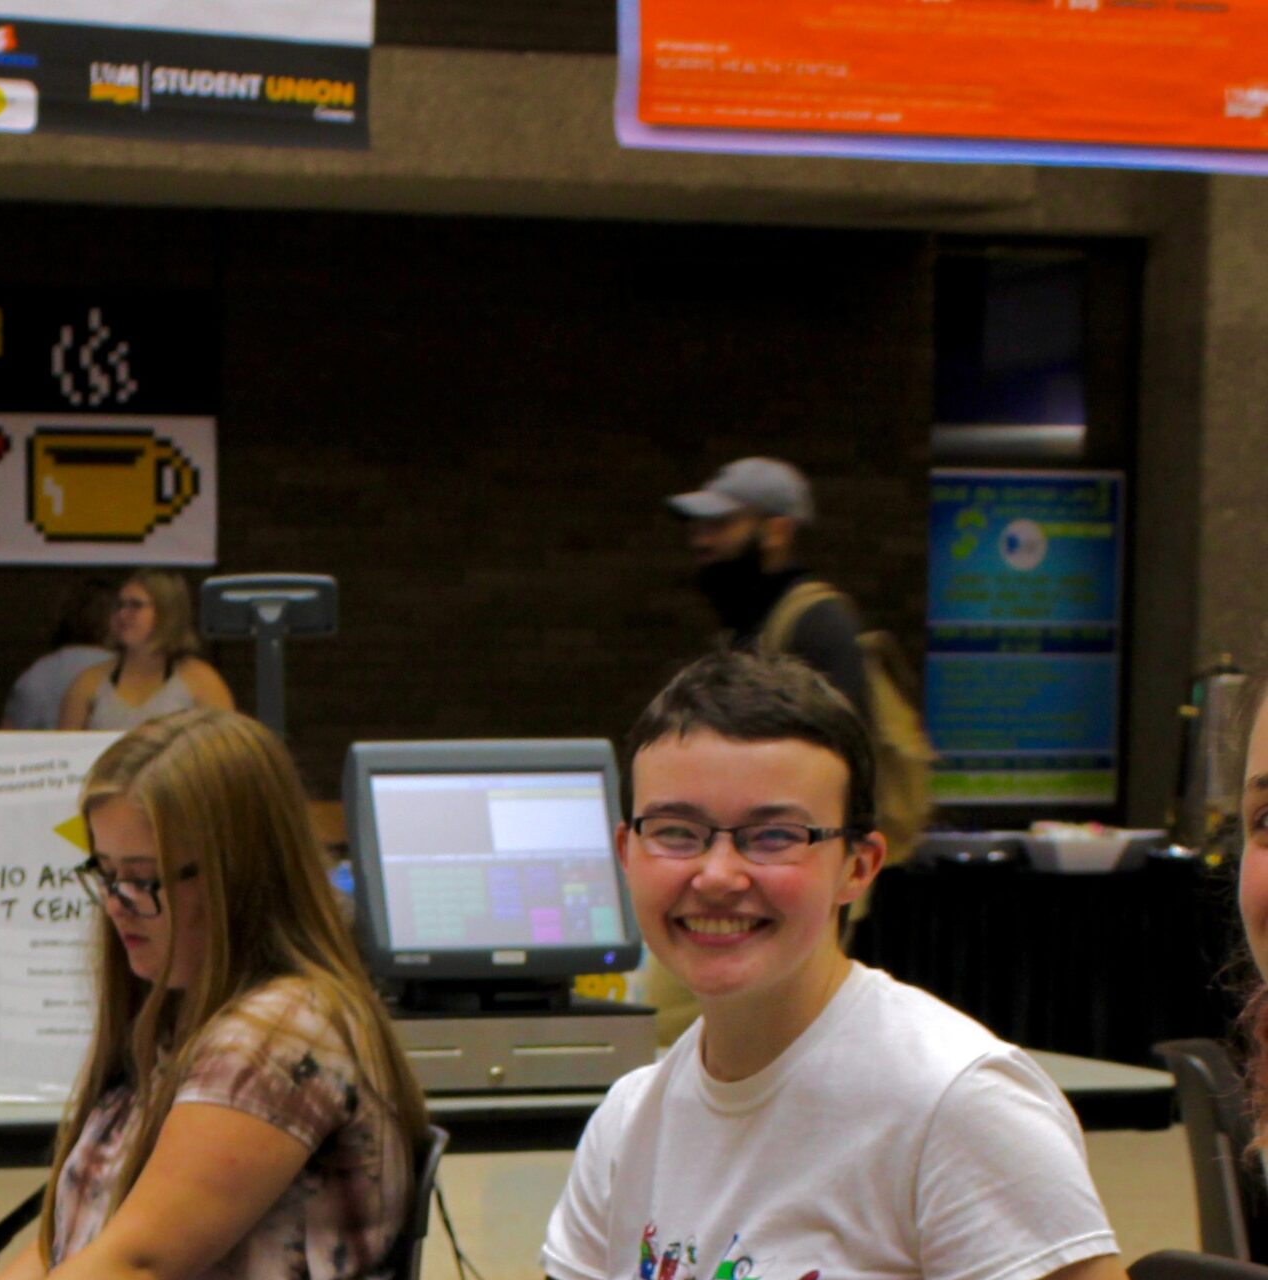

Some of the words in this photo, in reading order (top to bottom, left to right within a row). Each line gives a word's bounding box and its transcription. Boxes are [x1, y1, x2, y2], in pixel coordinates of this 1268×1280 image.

[151, 65, 263, 100] STUDENT
[265, 75, 356, 108] UNION
[19, 761, 54, 776] event
[56, 759, 70, 772] is
[47, 775, 66, 792] by
